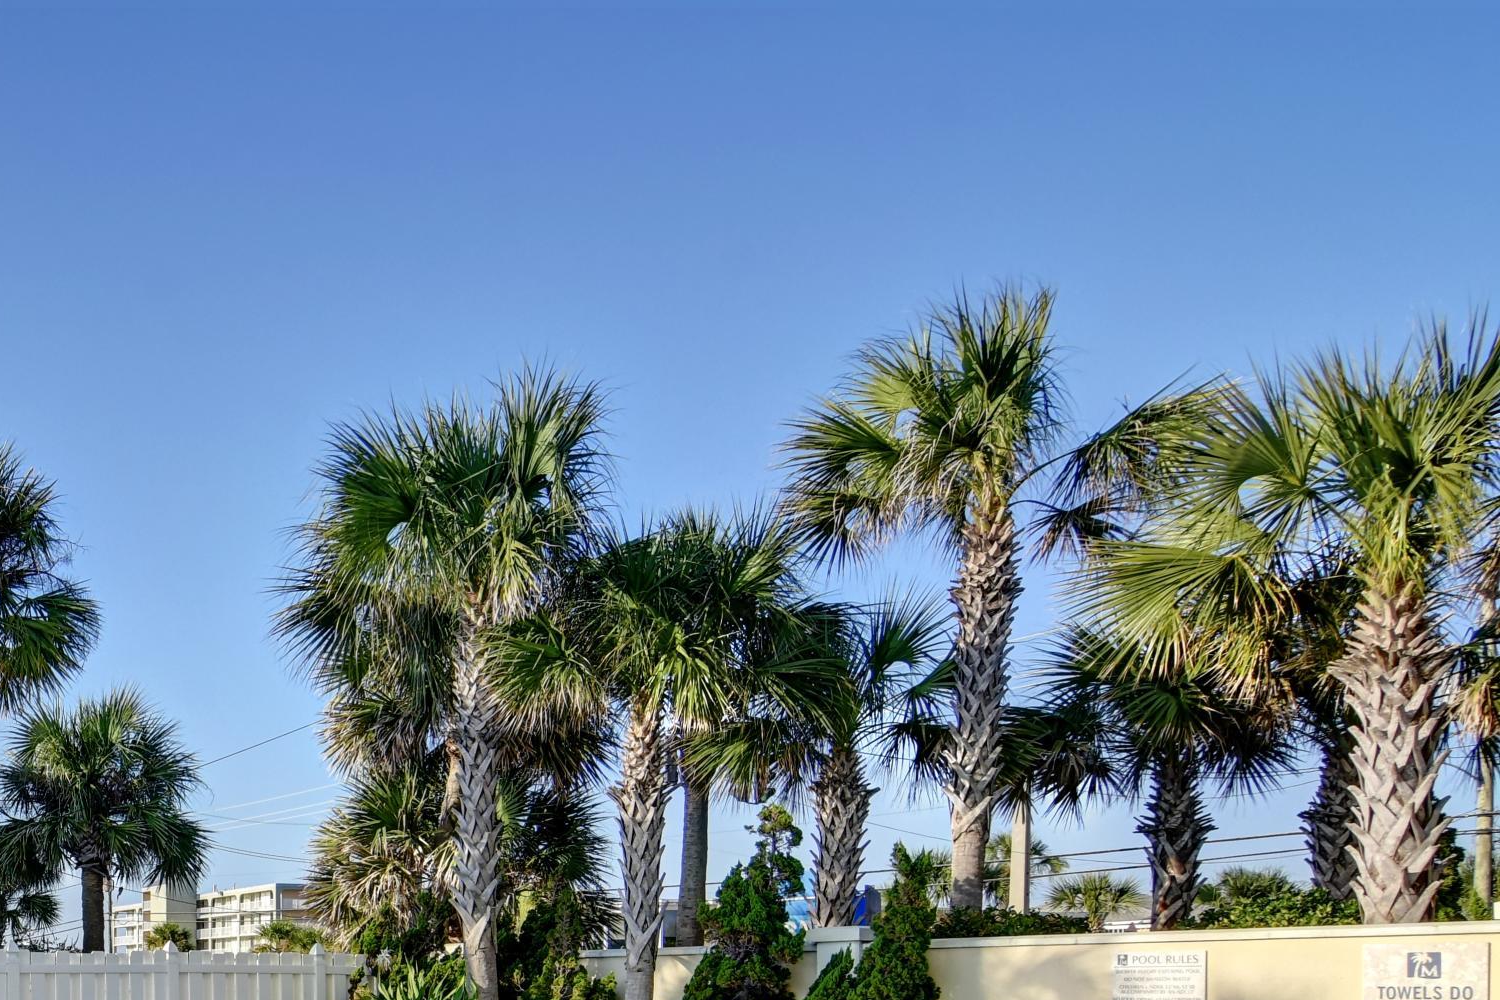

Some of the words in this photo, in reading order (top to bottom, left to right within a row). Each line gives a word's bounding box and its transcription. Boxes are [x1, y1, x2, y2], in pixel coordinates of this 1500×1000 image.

[1132, 955, 1161, 964] POOL
[1165, 954, 1199, 963] RULES
[1377, 986, 1442, 1000] TOWELS
[1450, 986, 1474, 1000] DO
